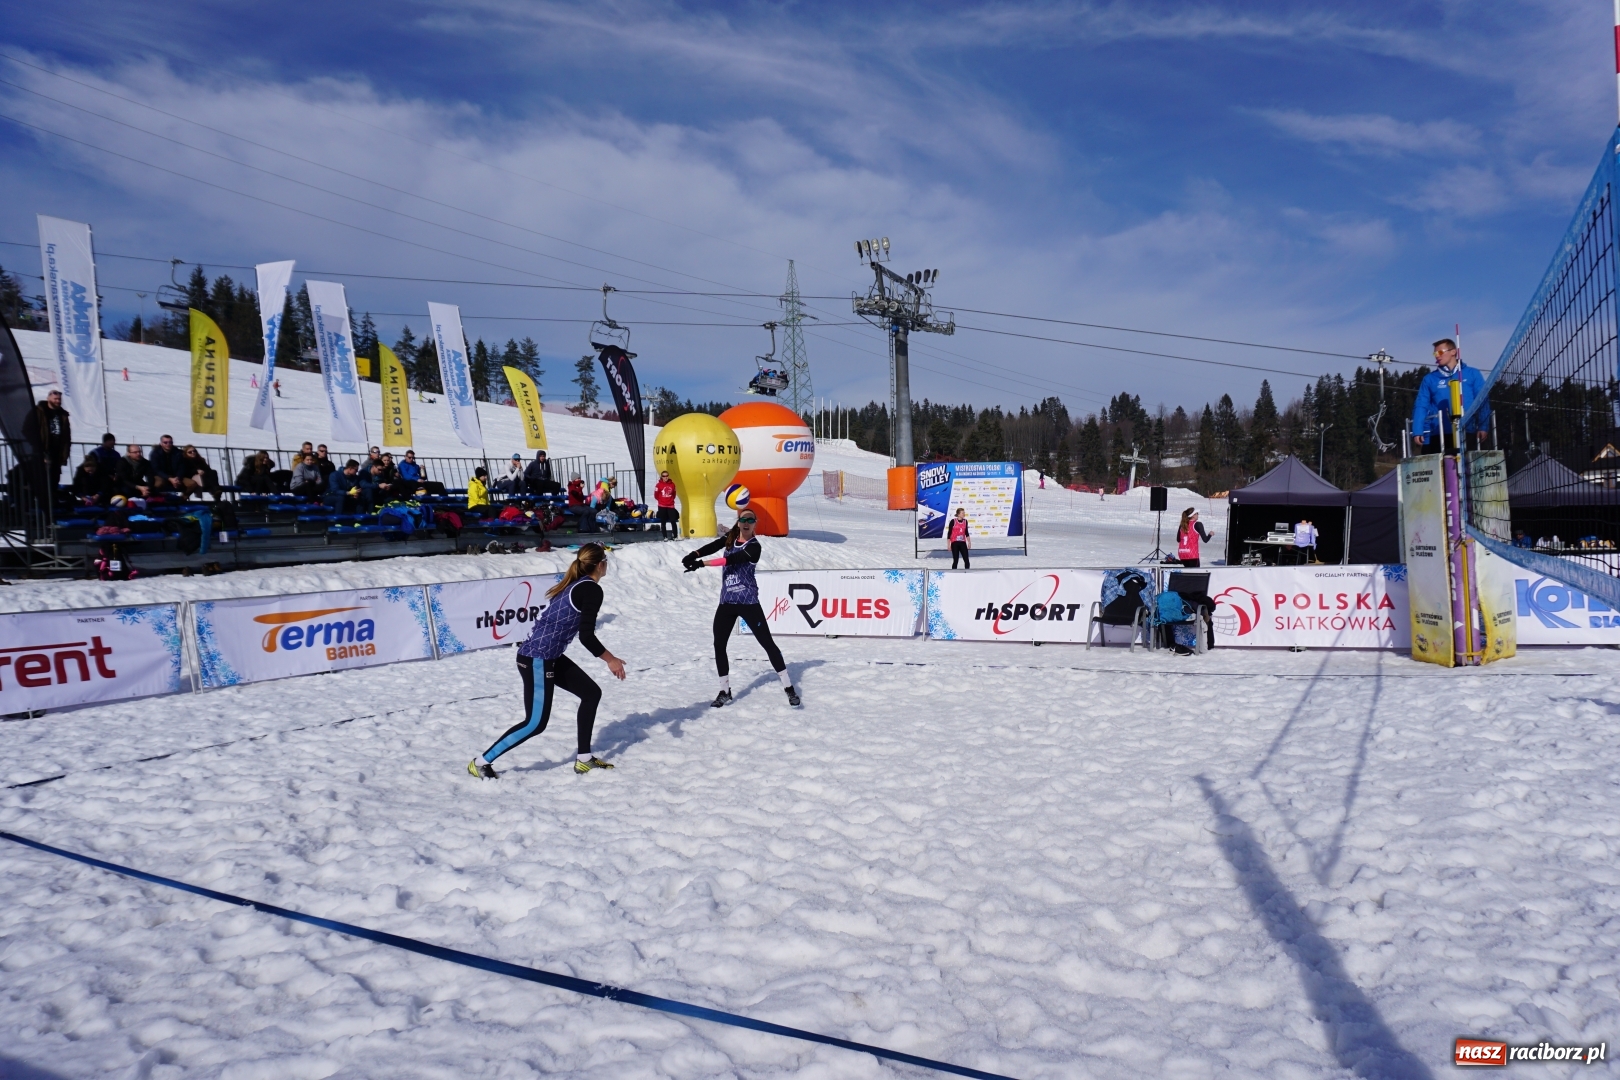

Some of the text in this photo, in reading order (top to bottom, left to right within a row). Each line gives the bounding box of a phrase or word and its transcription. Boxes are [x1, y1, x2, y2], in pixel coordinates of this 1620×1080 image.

[920, 465, 946, 480] SNOW
[920, 472, 950, 489] VOLLEY
[788, 584, 890, 629] RULES
[1275, 593, 1395, 610] POLSKA
[975, 603, 1080, 621] rhSPORT
[253, 606, 375, 653] Terma
[1275, 613, 1396, 631] SIATKÓWKA
[326, 643, 376, 661] Bania
